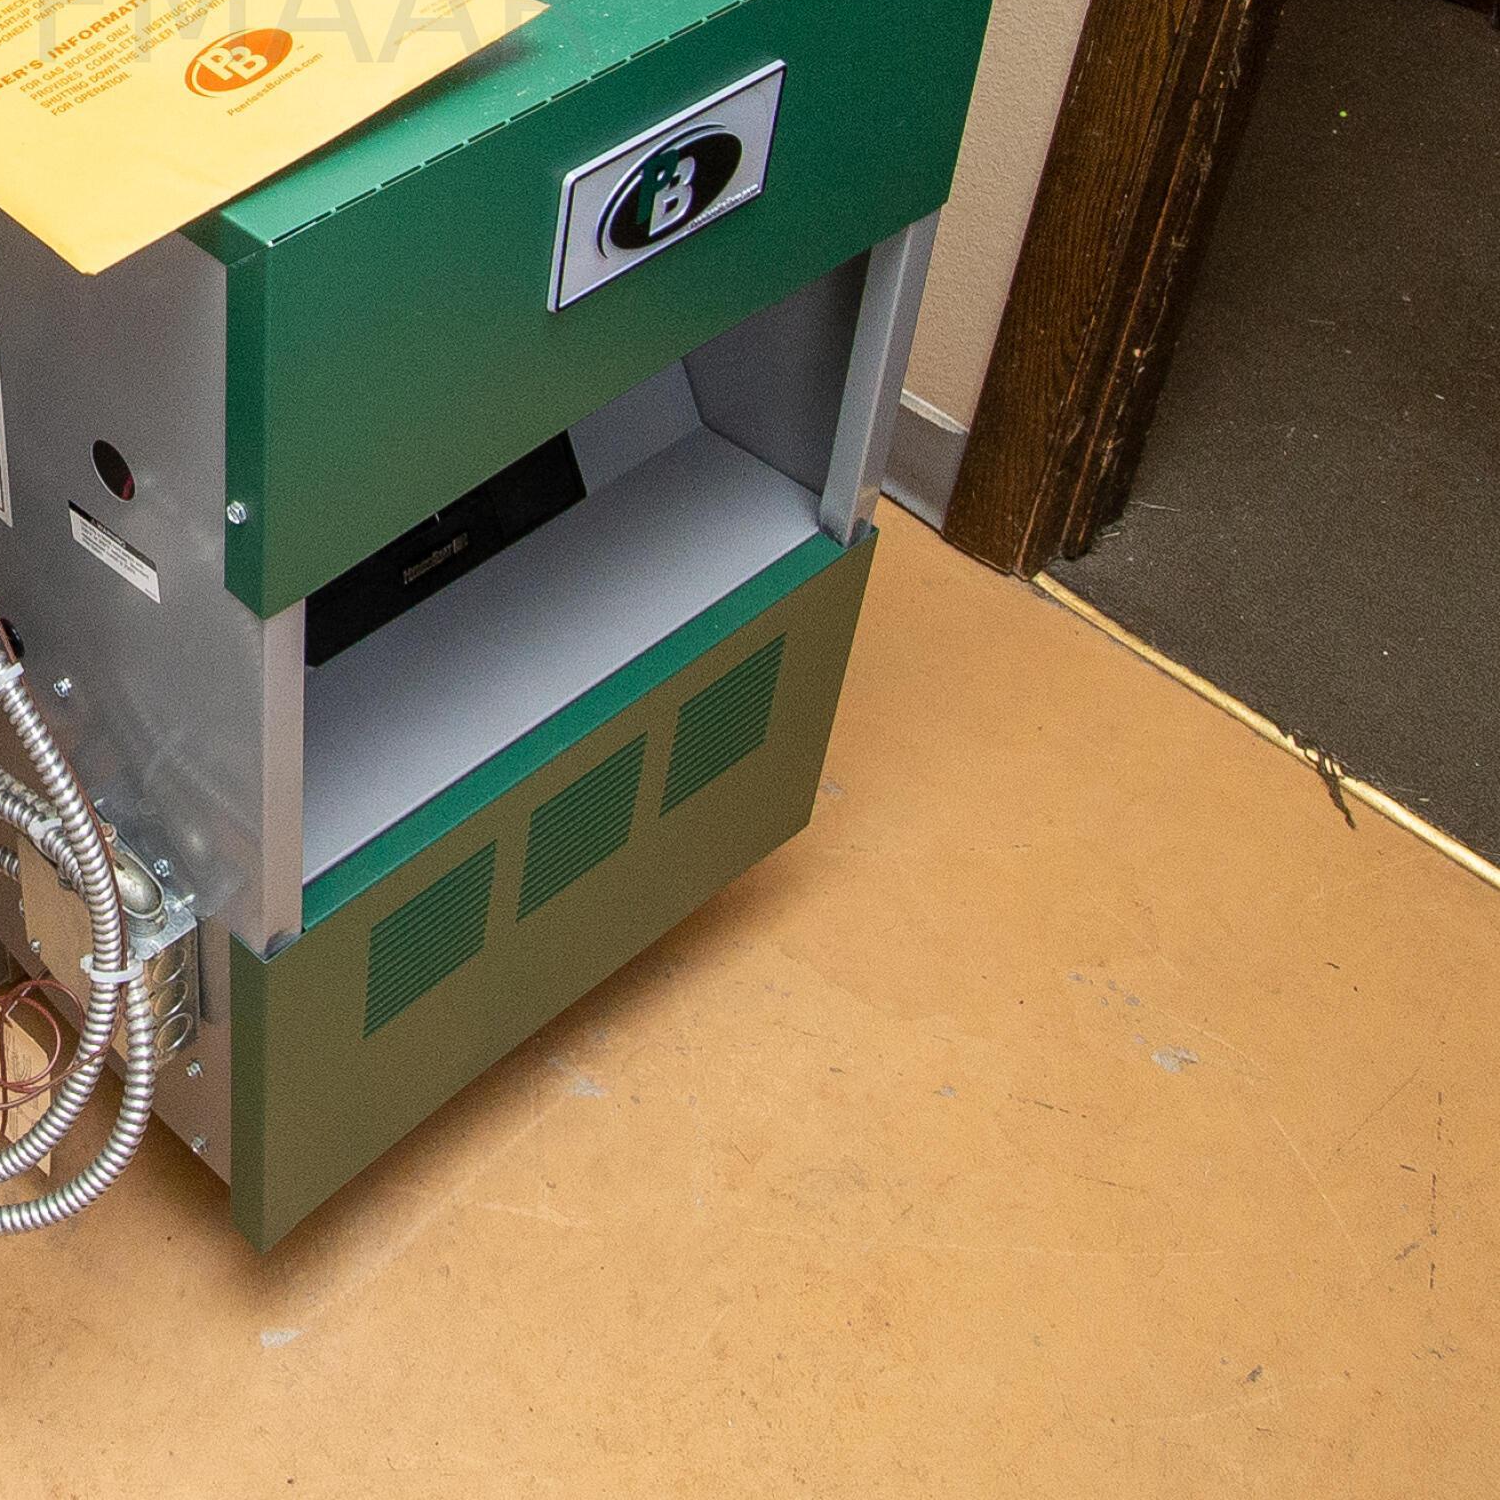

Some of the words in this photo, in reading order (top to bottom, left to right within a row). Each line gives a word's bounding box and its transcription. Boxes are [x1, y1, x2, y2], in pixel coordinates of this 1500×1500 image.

[32, 1, 65, 22] PARTS
[18, 77, 42, 94] FOR
[40, 65, 65, 82] GAS
[62, 39, 107, 68] BOILERS
[103, 23, 133, 43] ONLY
[28, 69, 84, 101] PROVIDES
[82, 33, 142, 71] COMPLETE
[38, 79, 90, 110] SHUTTING
[86, 61, 120, 83] DOWN
[116, 49, 140, 65] THE
[135, 27, 175, 53] BOILER
[171, 6, 209, 31] ALONG
[227, 53, 324, 116] PeerlessBoilers.com
[49, 100, 75, 118] FOR
